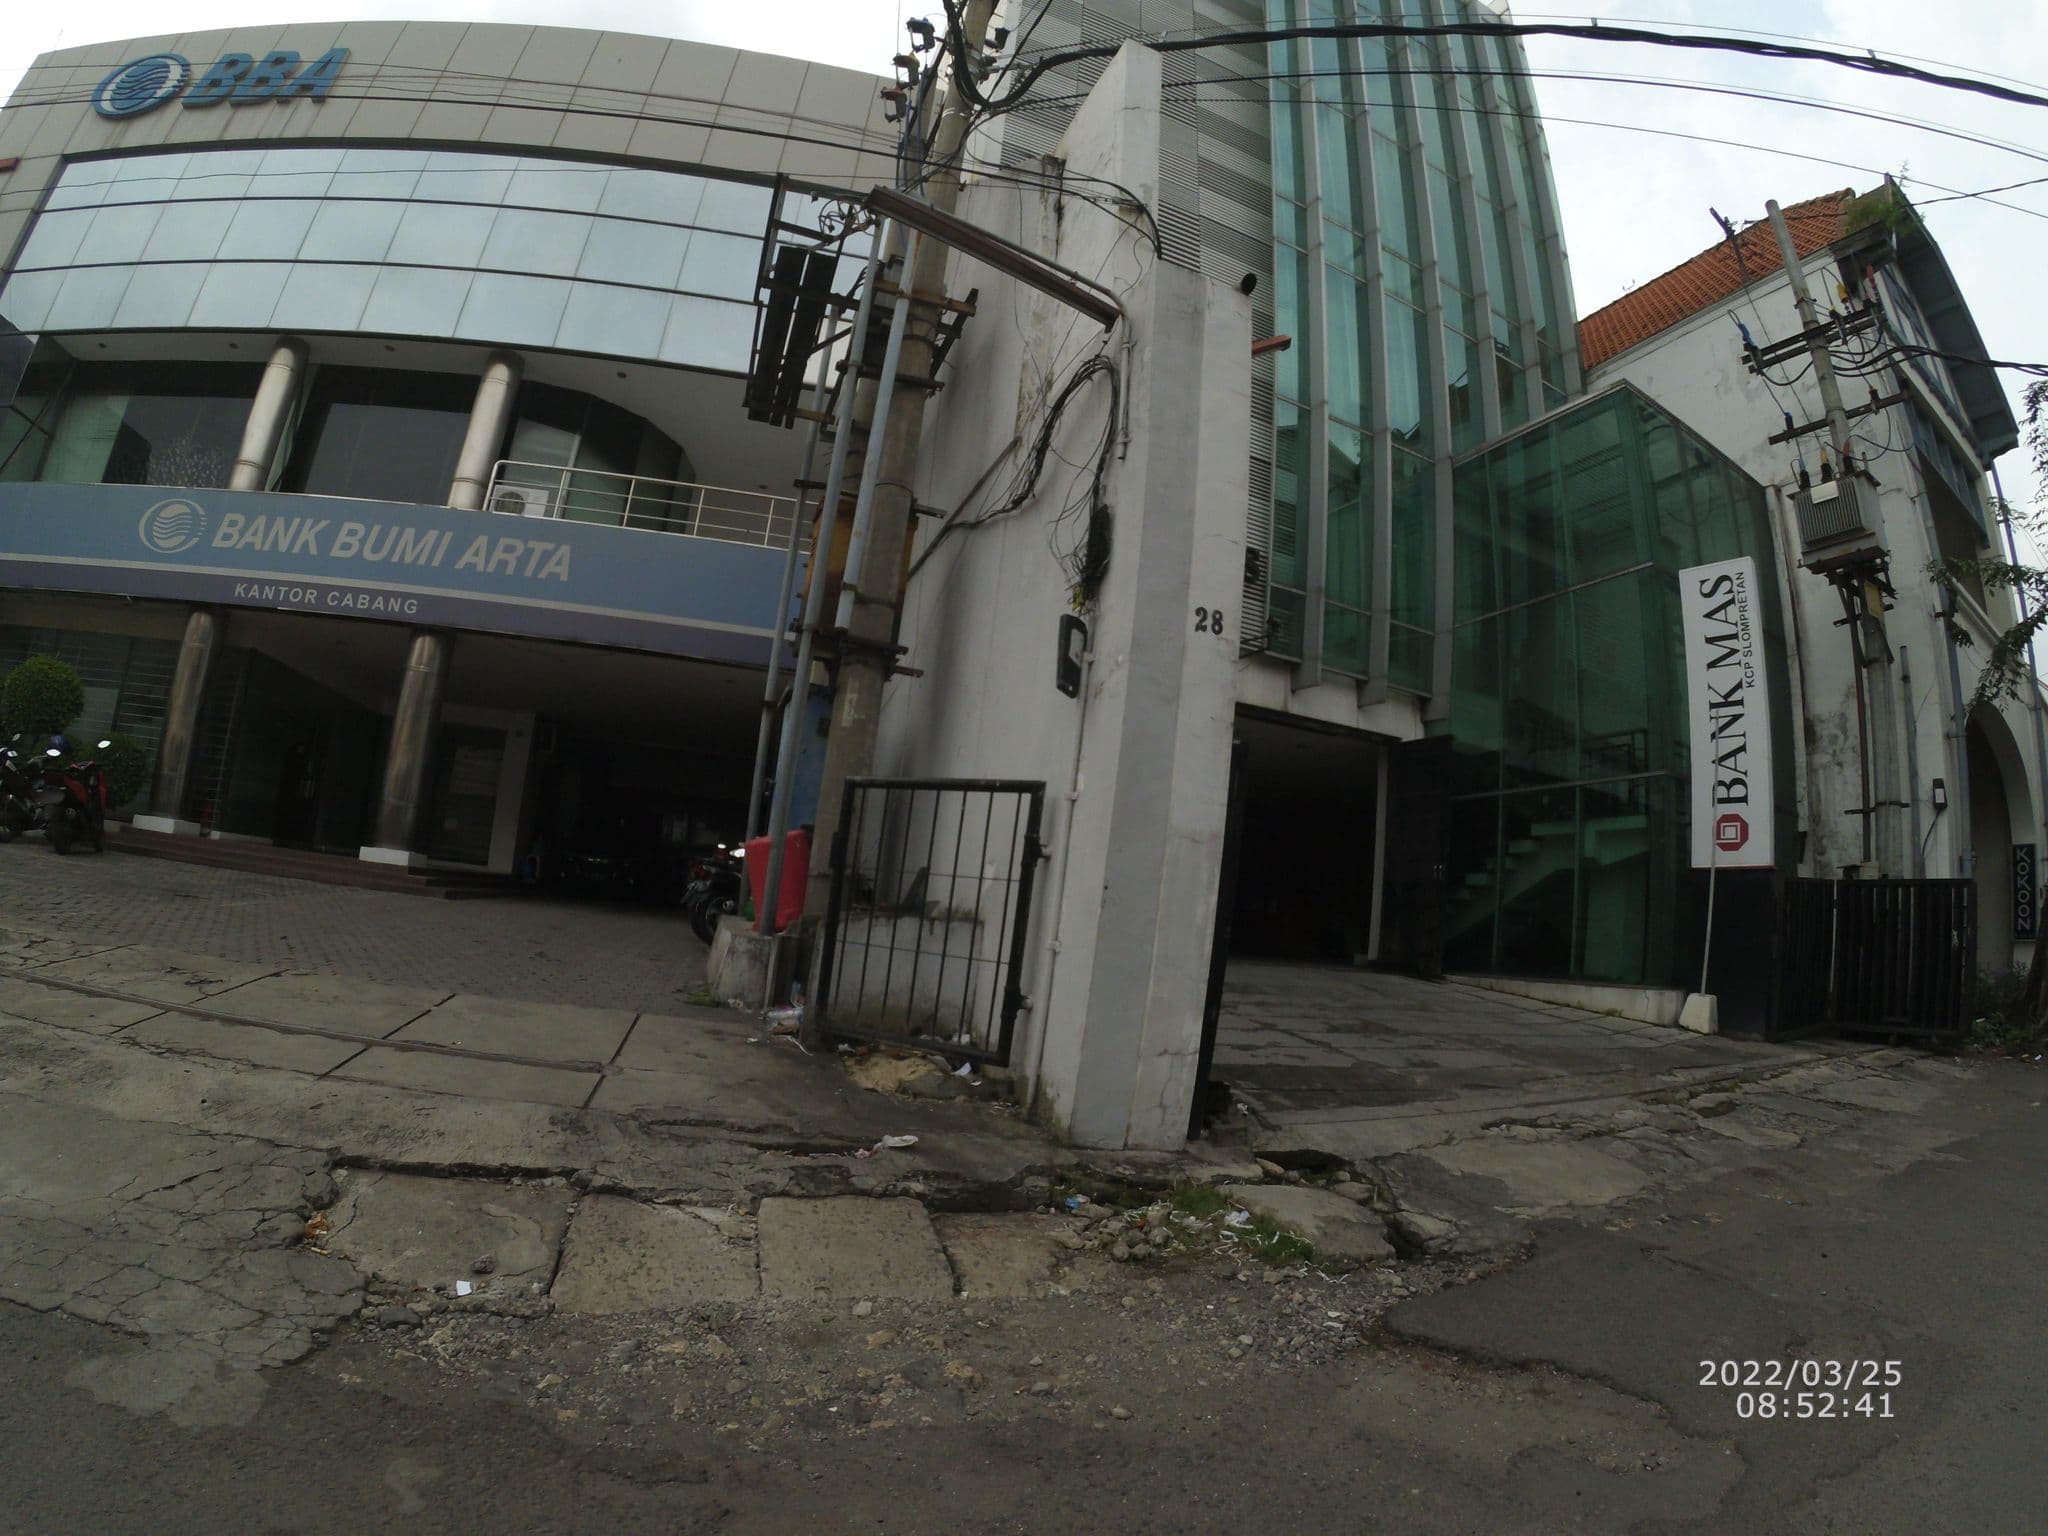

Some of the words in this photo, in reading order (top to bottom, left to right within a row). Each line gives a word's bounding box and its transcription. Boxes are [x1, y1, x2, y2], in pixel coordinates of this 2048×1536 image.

[181, 47, 351, 109] BBA
[212, 512, 330, 556] BANK
[330, 521, 453, 567] BUMI
[455, 535, 572, 582] ARTA
[234, 582, 318, 604] KANTOR
[327, 591, 418, 615] CABANG
[1194, 606, 1224, 636] 28
[1699, 573, 1743, 673] MAS
[1735, 571, 1753, 658] SLOMPRETAN
[1744, 661, 1756, 689] KCP
[1707, 677, 1750, 808] BANK
[2016, 847, 2032, 931] KOKOON
